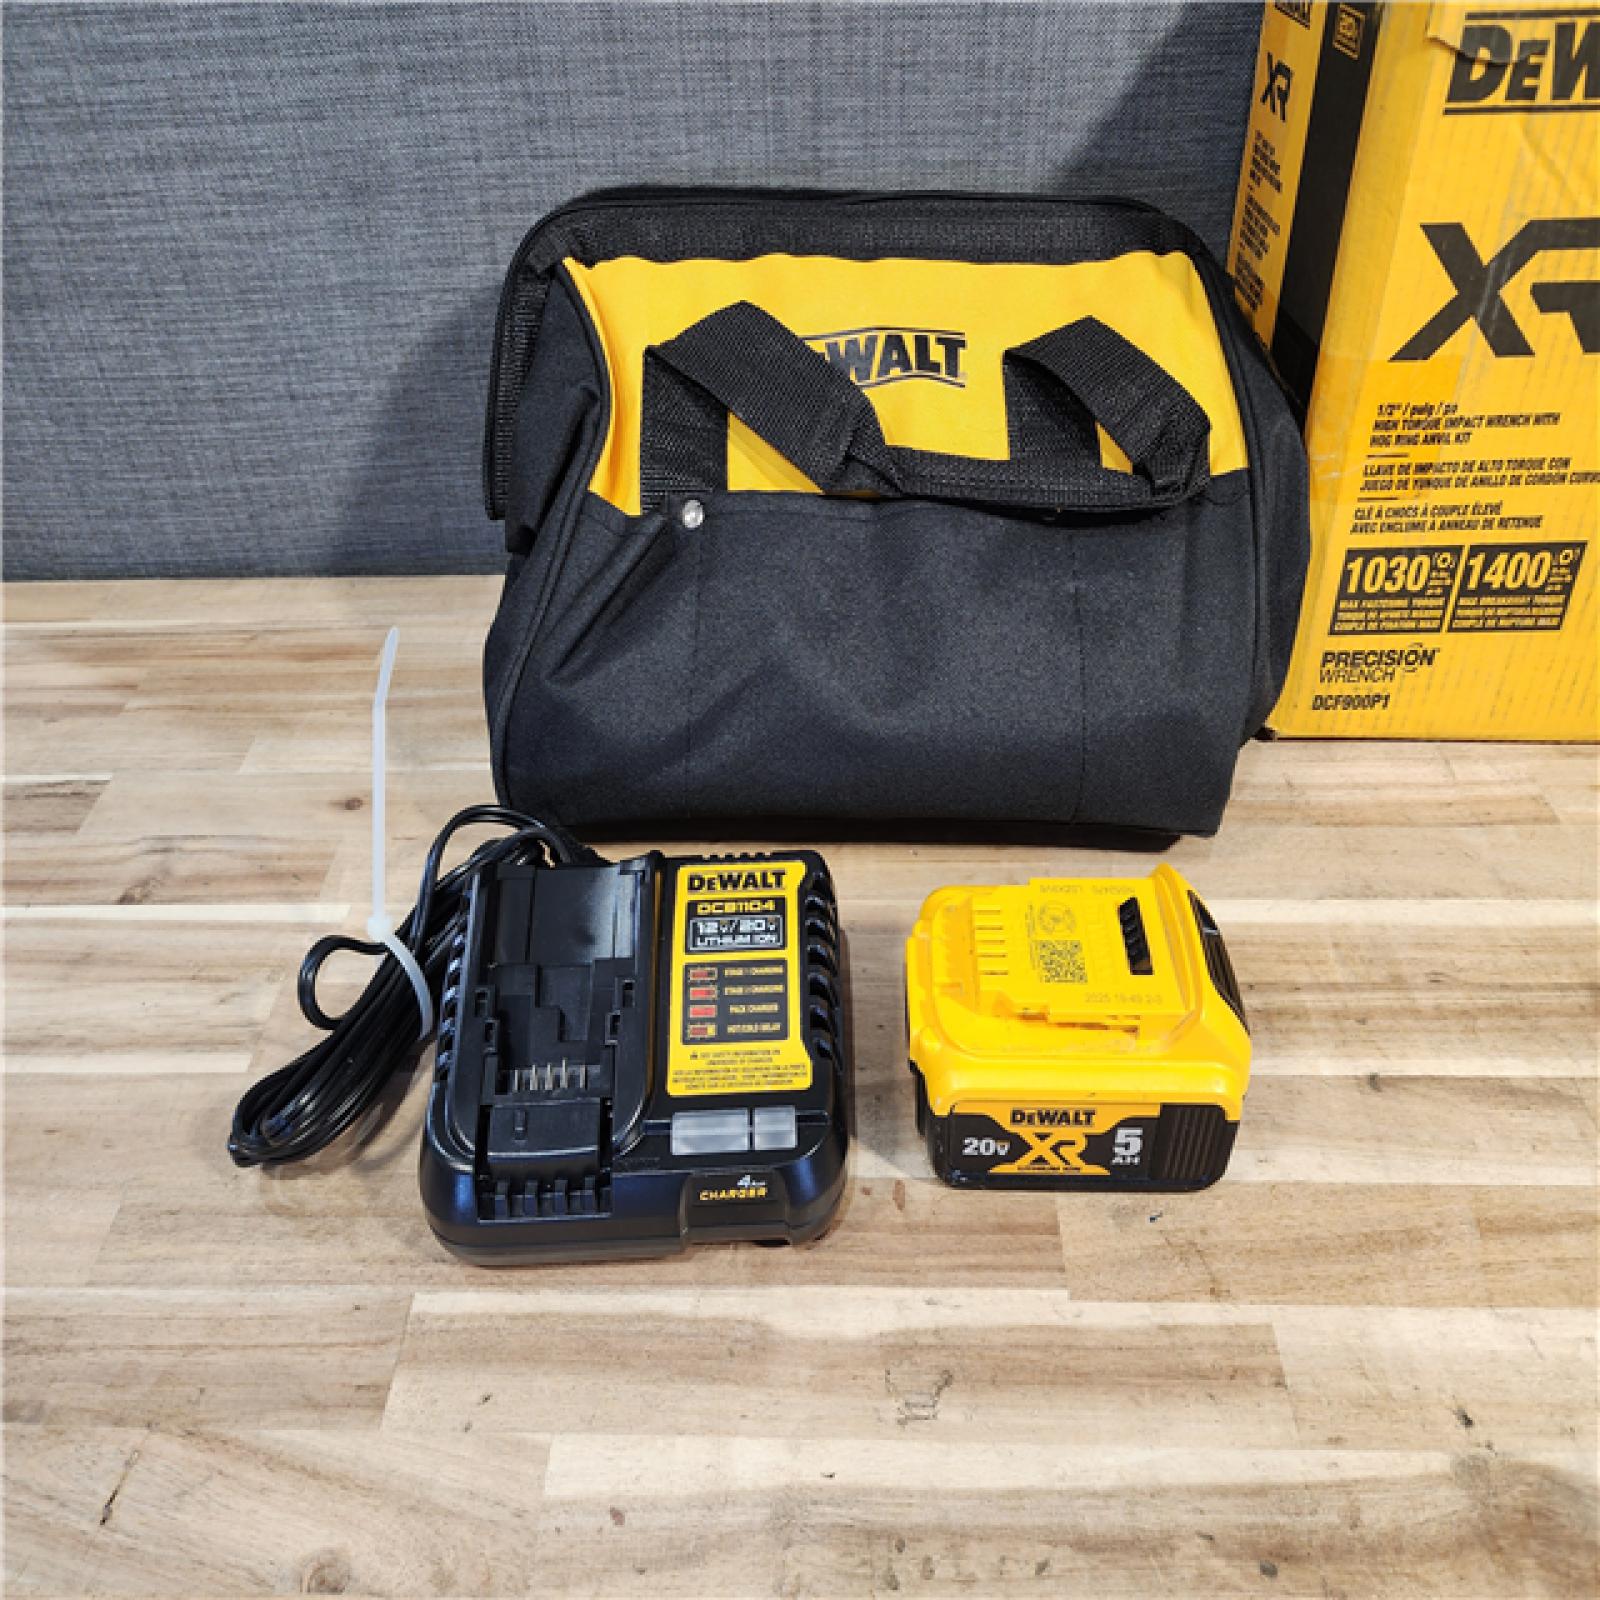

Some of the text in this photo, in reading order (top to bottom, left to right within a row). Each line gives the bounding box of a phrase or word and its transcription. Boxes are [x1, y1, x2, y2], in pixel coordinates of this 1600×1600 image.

[1260, 52, 1294, 123] XR
[820, 334, 967, 382] WALT
[1373, 412, 1561, 432] HIGH TORQUE IMPACT WRENCH WITH
[1455, 431, 1472, 443] KIT
[1363, 457, 1571, 477] LLAVE DE IMPACTO DE ALTO TORQUE CON
[1455, 477, 1469, 488] DE
[1430, 503, 1470, 517] COUPLE
[1350, 522, 1377, 535] AVEC
[1482, 518, 1495, 530] DE
[1346, 554, 1431, 594] 1030
[1467, 551, 1551, 591] 1400
[1321, 648, 1437, 668] PRECISION
[1319, 667, 1396, 683] WRENCH
[1312, 694, 1390, 711] DCF900P1
[1015, 1133, 1088, 1166] XR
[1113, 1127, 1144, 1156] 5
[737, 1175, 751, 1188] 4
[700, 1187, 768, 1201] CHARGER
